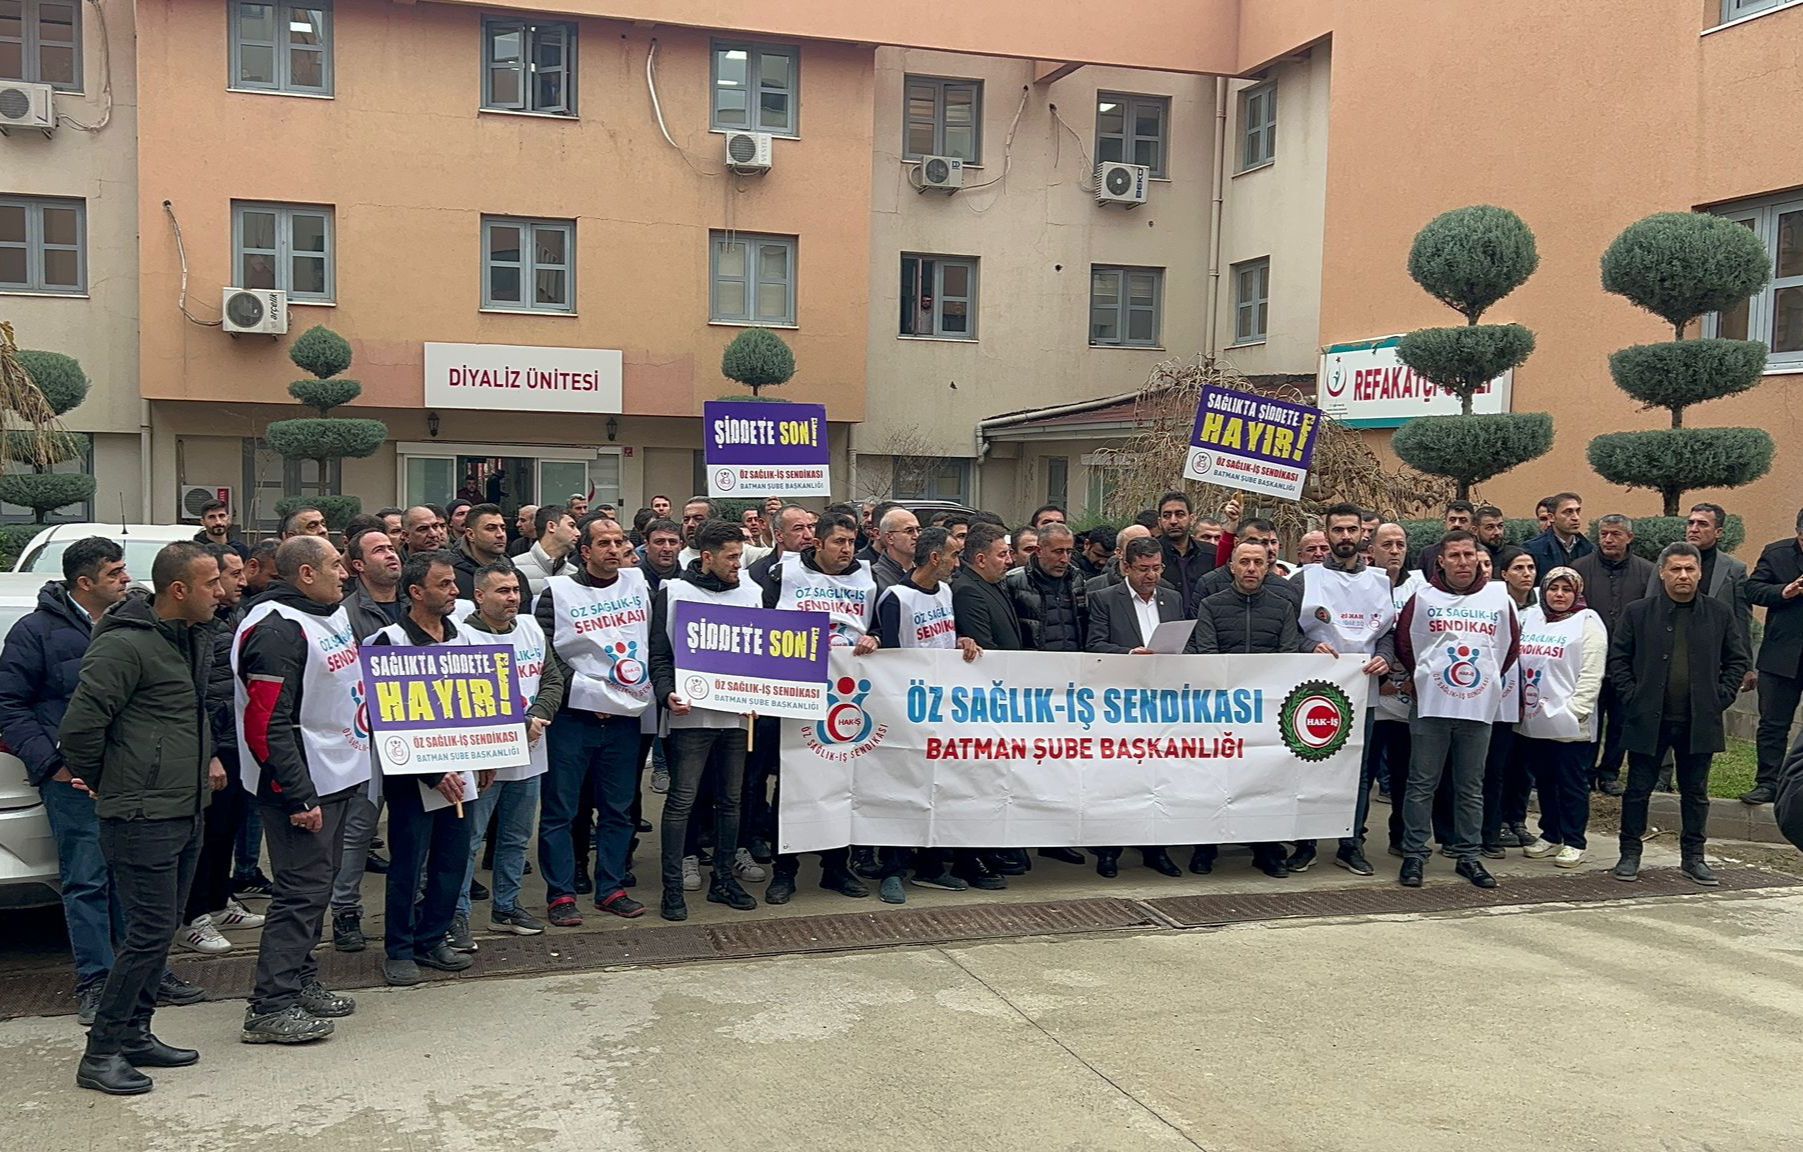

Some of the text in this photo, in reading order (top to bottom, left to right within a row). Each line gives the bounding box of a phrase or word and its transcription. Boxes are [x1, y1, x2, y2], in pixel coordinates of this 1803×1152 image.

[269, 293, 279, 320] arçelik
[449, 365, 599, 391] DİYALİZ ÜNİTESİ
[1207, 392, 1258, 418] SAĞLIKTA
[1258, 402, 1300, 427] ŞİDDETE
[714, 415, 818, 449] ŞİDDETE SON!
[1200, 412, 1316, 461] HAYIR!
[739, 468, 824, 480] ÖZ SAĞLIK-İŞ SENDİKASI
[1213, 469, 1240, 480] BATMAN
[1216, 456, 1299, 482] ÖZ SAĞLIK-İŞ SENDİKASI
[795, 585, 865, 603] ÖZ SAĞLIK-İŞ
[570, 595, 642, 618] ÖZ SAĞLIK-İŞ
[796, 599, 865, 617] SENDİKASI
[1427, 605, 1498, 622] ÖZ SAĞLIK-İŞ
[574, 609, 646, 634] SENDİKASI
[914, 612, 927, 625] ÖZ
[1429, 619, 1497, 636] SENDİKASI
[687, 618, 820, 662] ŞİDDETE SON!
[370, 651, 438, 677] SAĞLIKTA
[439, 651, 492, 679] ŞİDDETE
[375, 652, 512, 722] HAYIR!
[714, 679, 820, 699] ÖZ SAĞLIK-İŞ SENDİKASI
[714, 694, 747, 704] BATMAN
[907, 679, 1263, 730] ÖZ SAĞLIK-İŞ SENDİKASI
[838, 717, 862, 726] HAK-İŞ
[1306, 717, 1338, 727] HAK-İŞ
[413, 730, 518, 748] ÖZ SAĞLIK-İŞ SENDİKASI
[926, 732, 1243, 765] BATMAN ŞUBE BAŞKANLIĞI
[416, 751, 449, 763] BATMAN
[807, 739, 848, 763] SAĞLIK-İŞ
